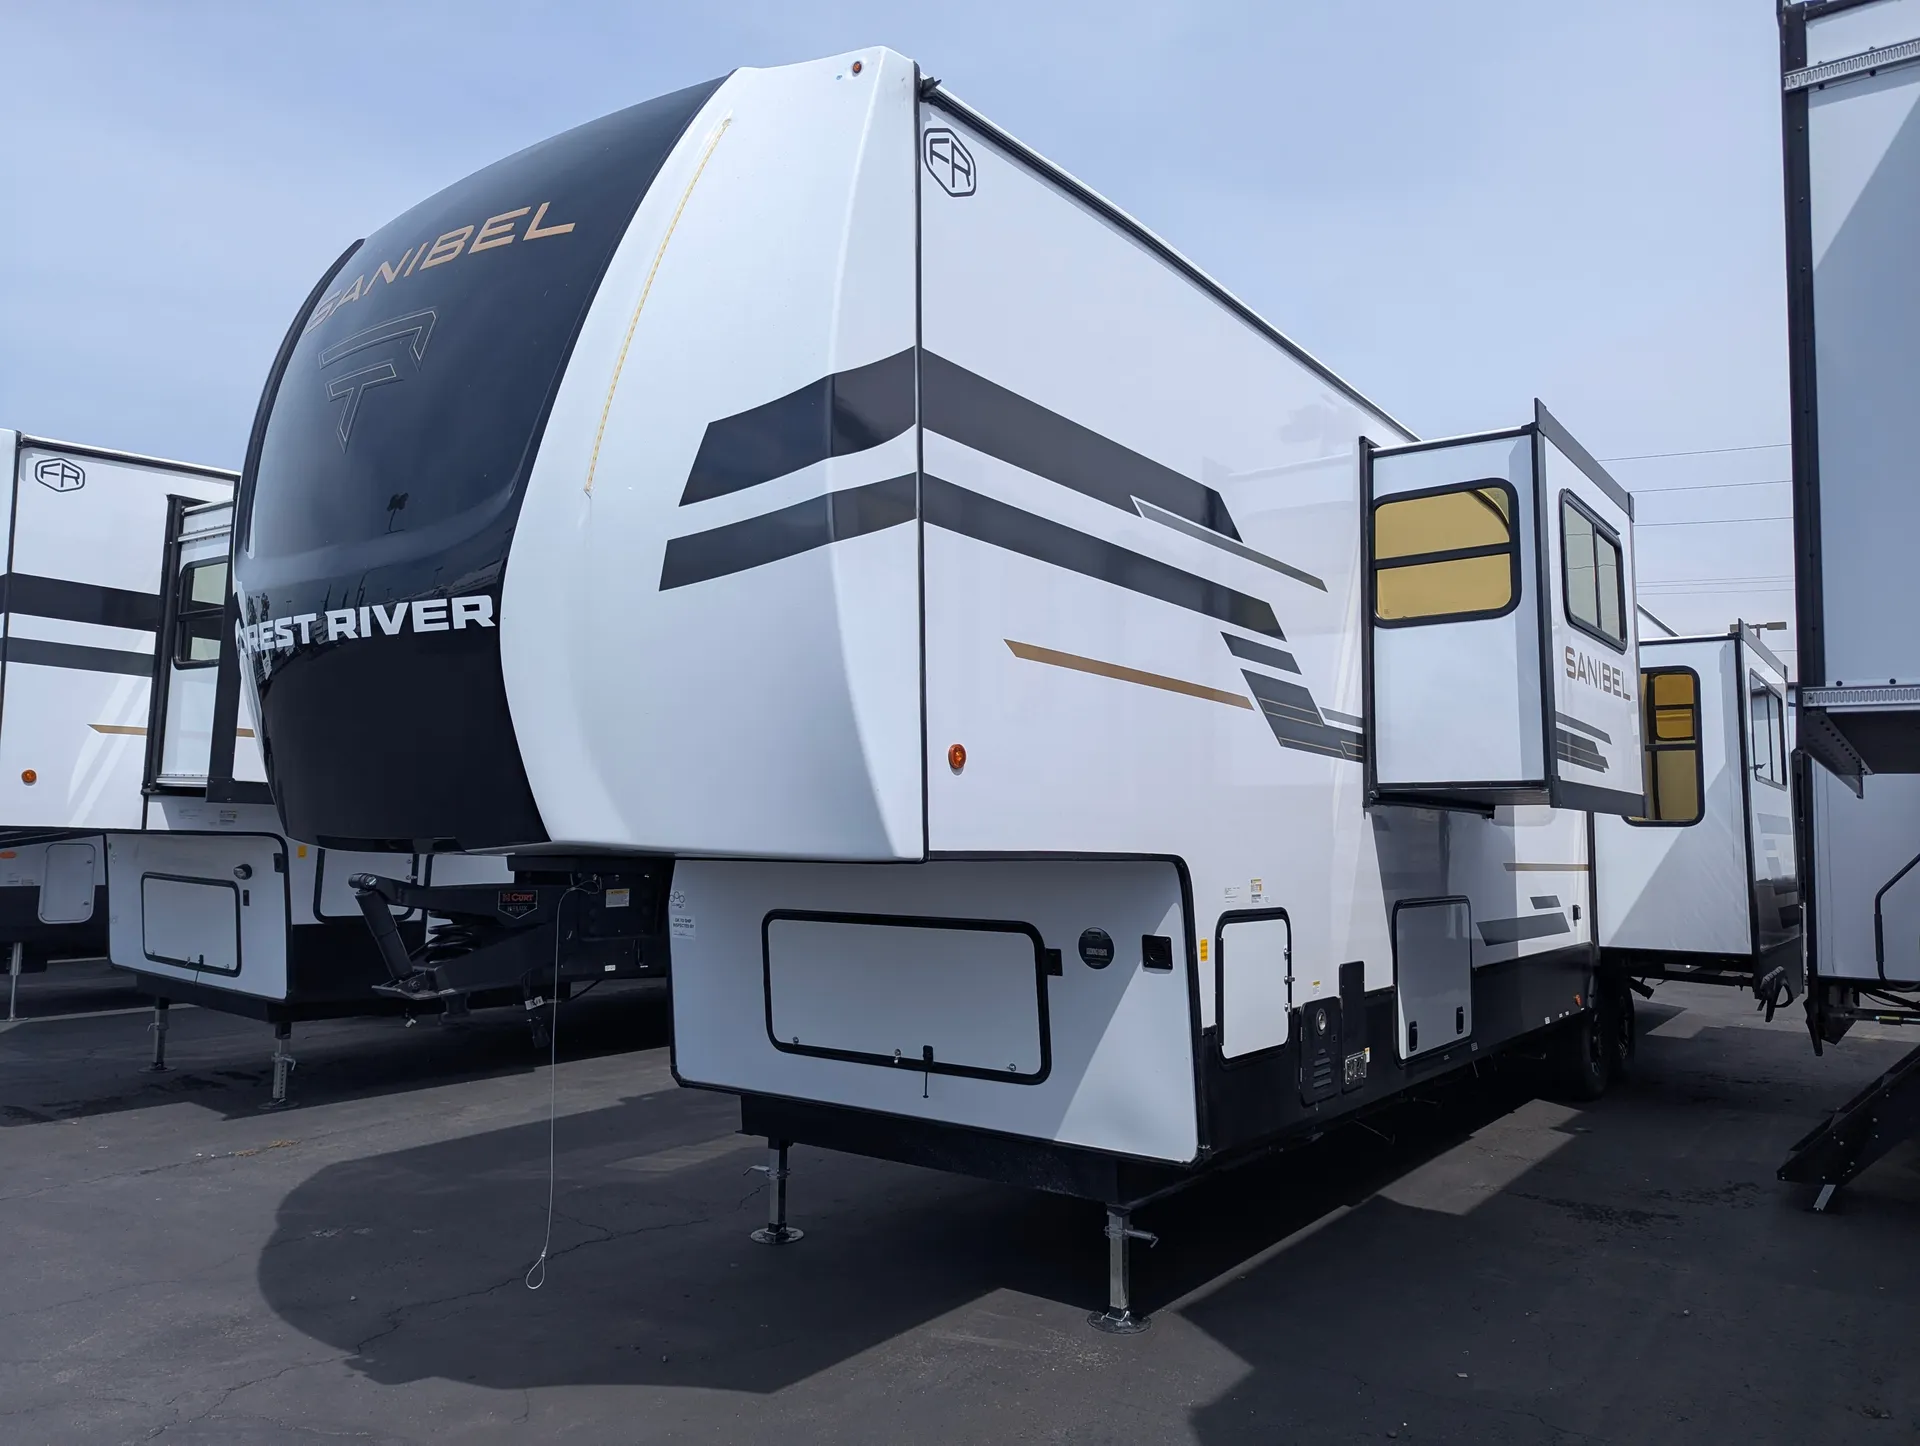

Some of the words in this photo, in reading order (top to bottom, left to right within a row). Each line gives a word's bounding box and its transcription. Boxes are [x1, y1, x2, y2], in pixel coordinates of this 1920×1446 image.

[305, 201, 576, 335] SANIBEL
[324, 594, 496, 642] RIVER
[1565, 645, 1631, 702] SANIBEL
